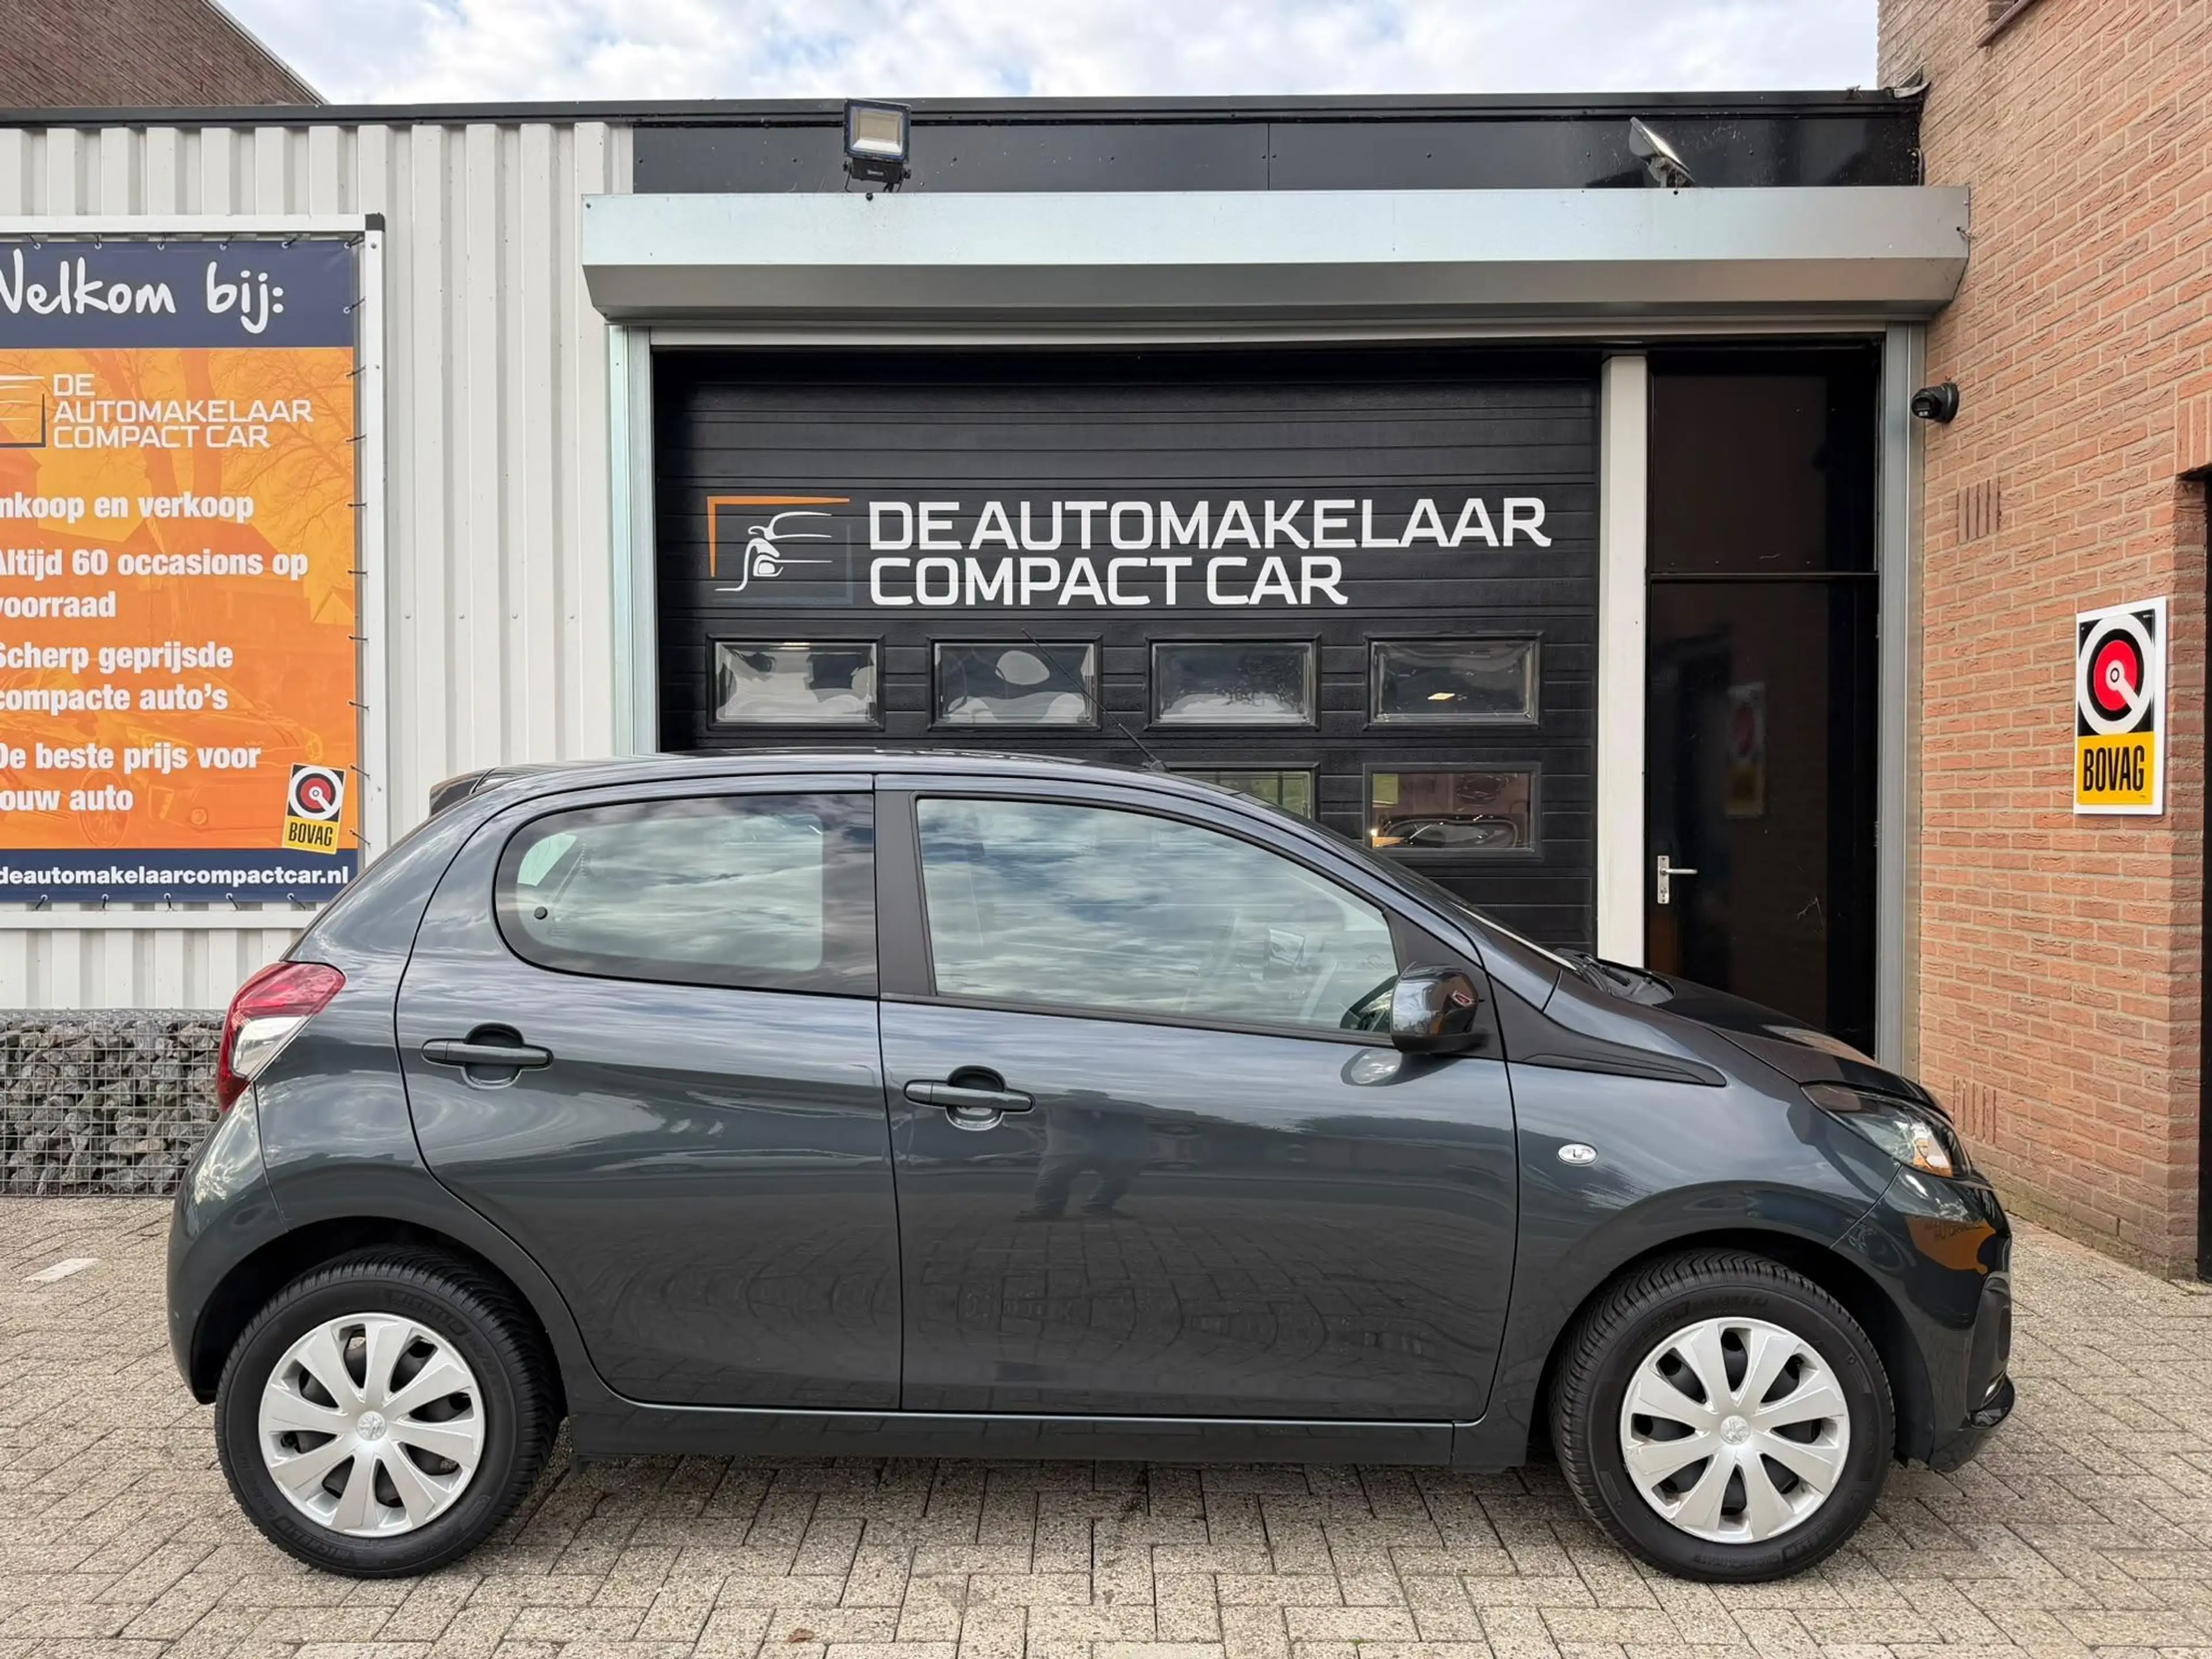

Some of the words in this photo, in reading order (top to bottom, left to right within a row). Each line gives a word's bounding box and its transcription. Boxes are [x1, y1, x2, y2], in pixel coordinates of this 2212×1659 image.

[207, 262, 283, 334] bij:
[54, 374, 95, 396] DE
[54, 400, 313, 423] AUTOMAKELAAR
[54, 426, 199, 448] COMPACT
[207, 425, 270, 448] CAR
[94, 497, 128, 518] en
[138, 492, 253, 523] verkoop
[869, 502, 962, 550] DE
[969, 498, 1551, 550] AUTOMAKELAAR
[73, 550, 108, 575] 60
[118, 549, 263, 575] occasions
[273, 554, 308, 580] op
[870, 557, 1192, 605] COMPACT
[1207, 556, 1348, 604] CAR
[0, 592, 115, 618] oorraad
[99, 642, 233, 674] geprijsde
[36, 743, 113, 768] beste
[124, 743, 187, 774] prijs
[198, 748, 261, 768] voor
[2084, 745, 2144, 791] BOVAG
[70, 785, 133, 810] auto
[289, 822, 332, 846] BOVAG
